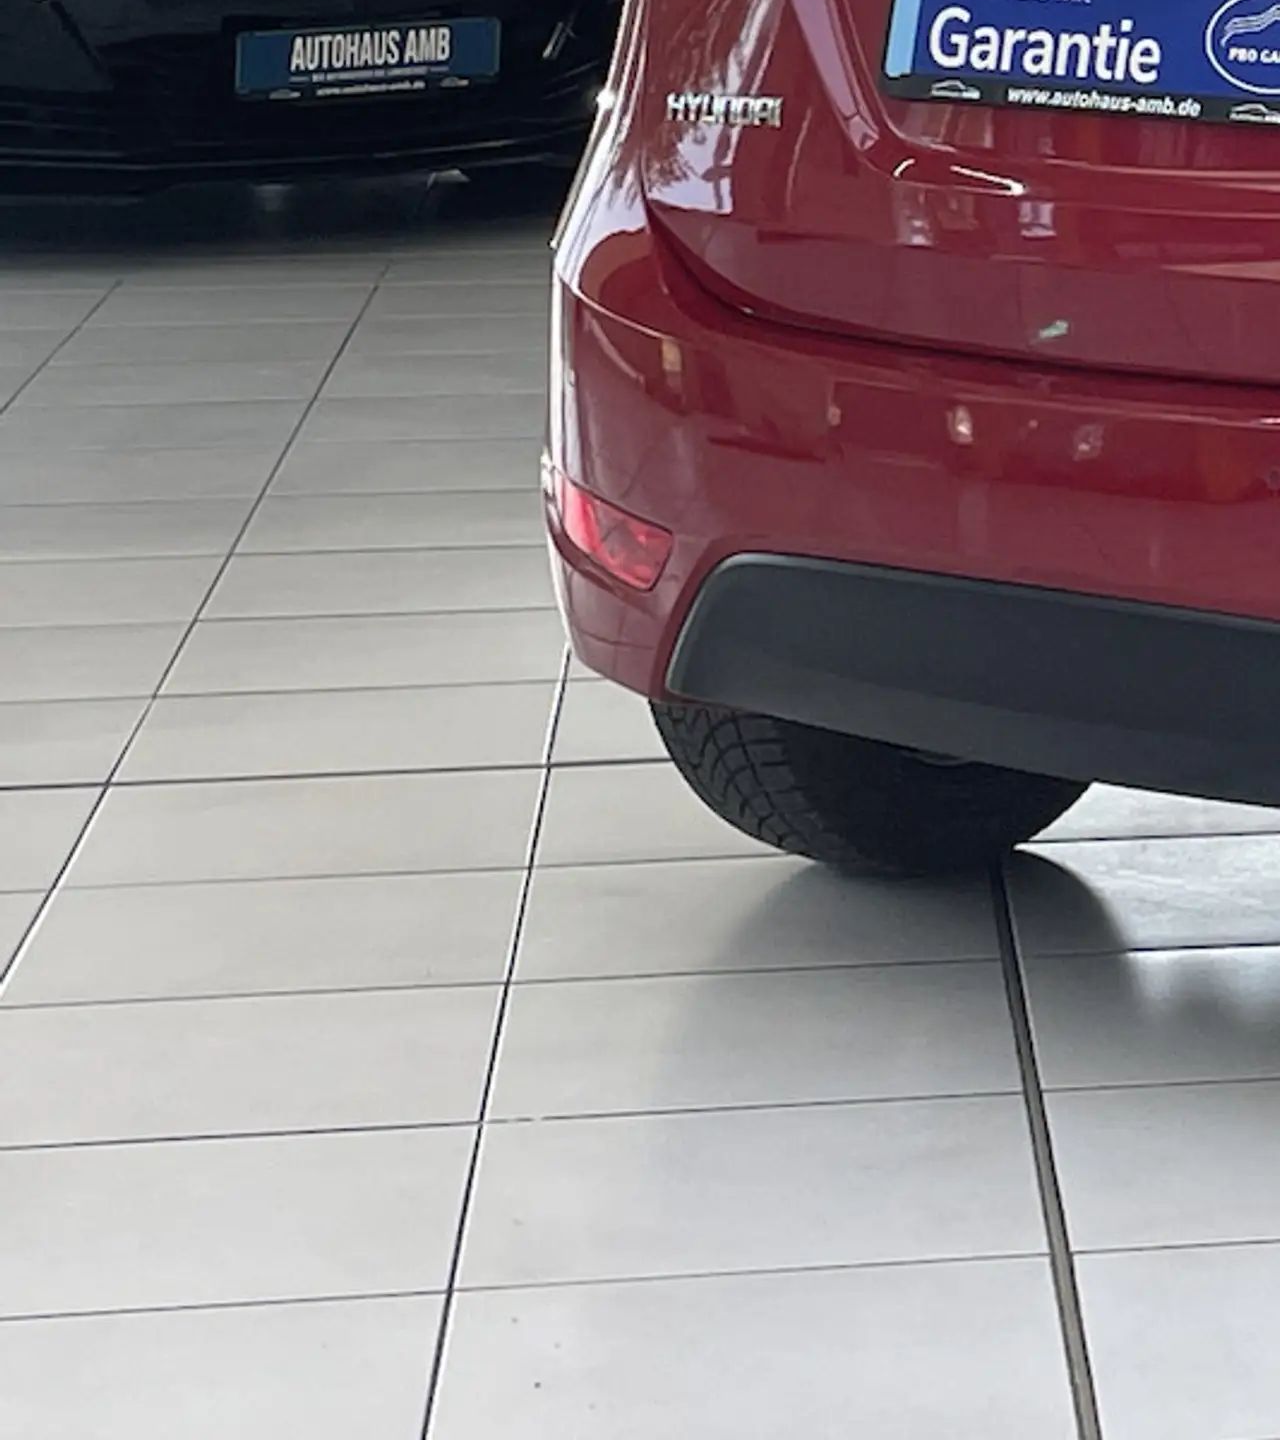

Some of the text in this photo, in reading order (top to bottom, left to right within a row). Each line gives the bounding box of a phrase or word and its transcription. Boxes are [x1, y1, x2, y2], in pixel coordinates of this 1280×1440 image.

[289, 26, 451, 72] AUTOHAUS AMB
[929, 6, 1162, 84] Garantie
[666, 92, 784, 128] HYUNDAI
[1007, 87, 1202, 118] www.autohaus-amb.de
